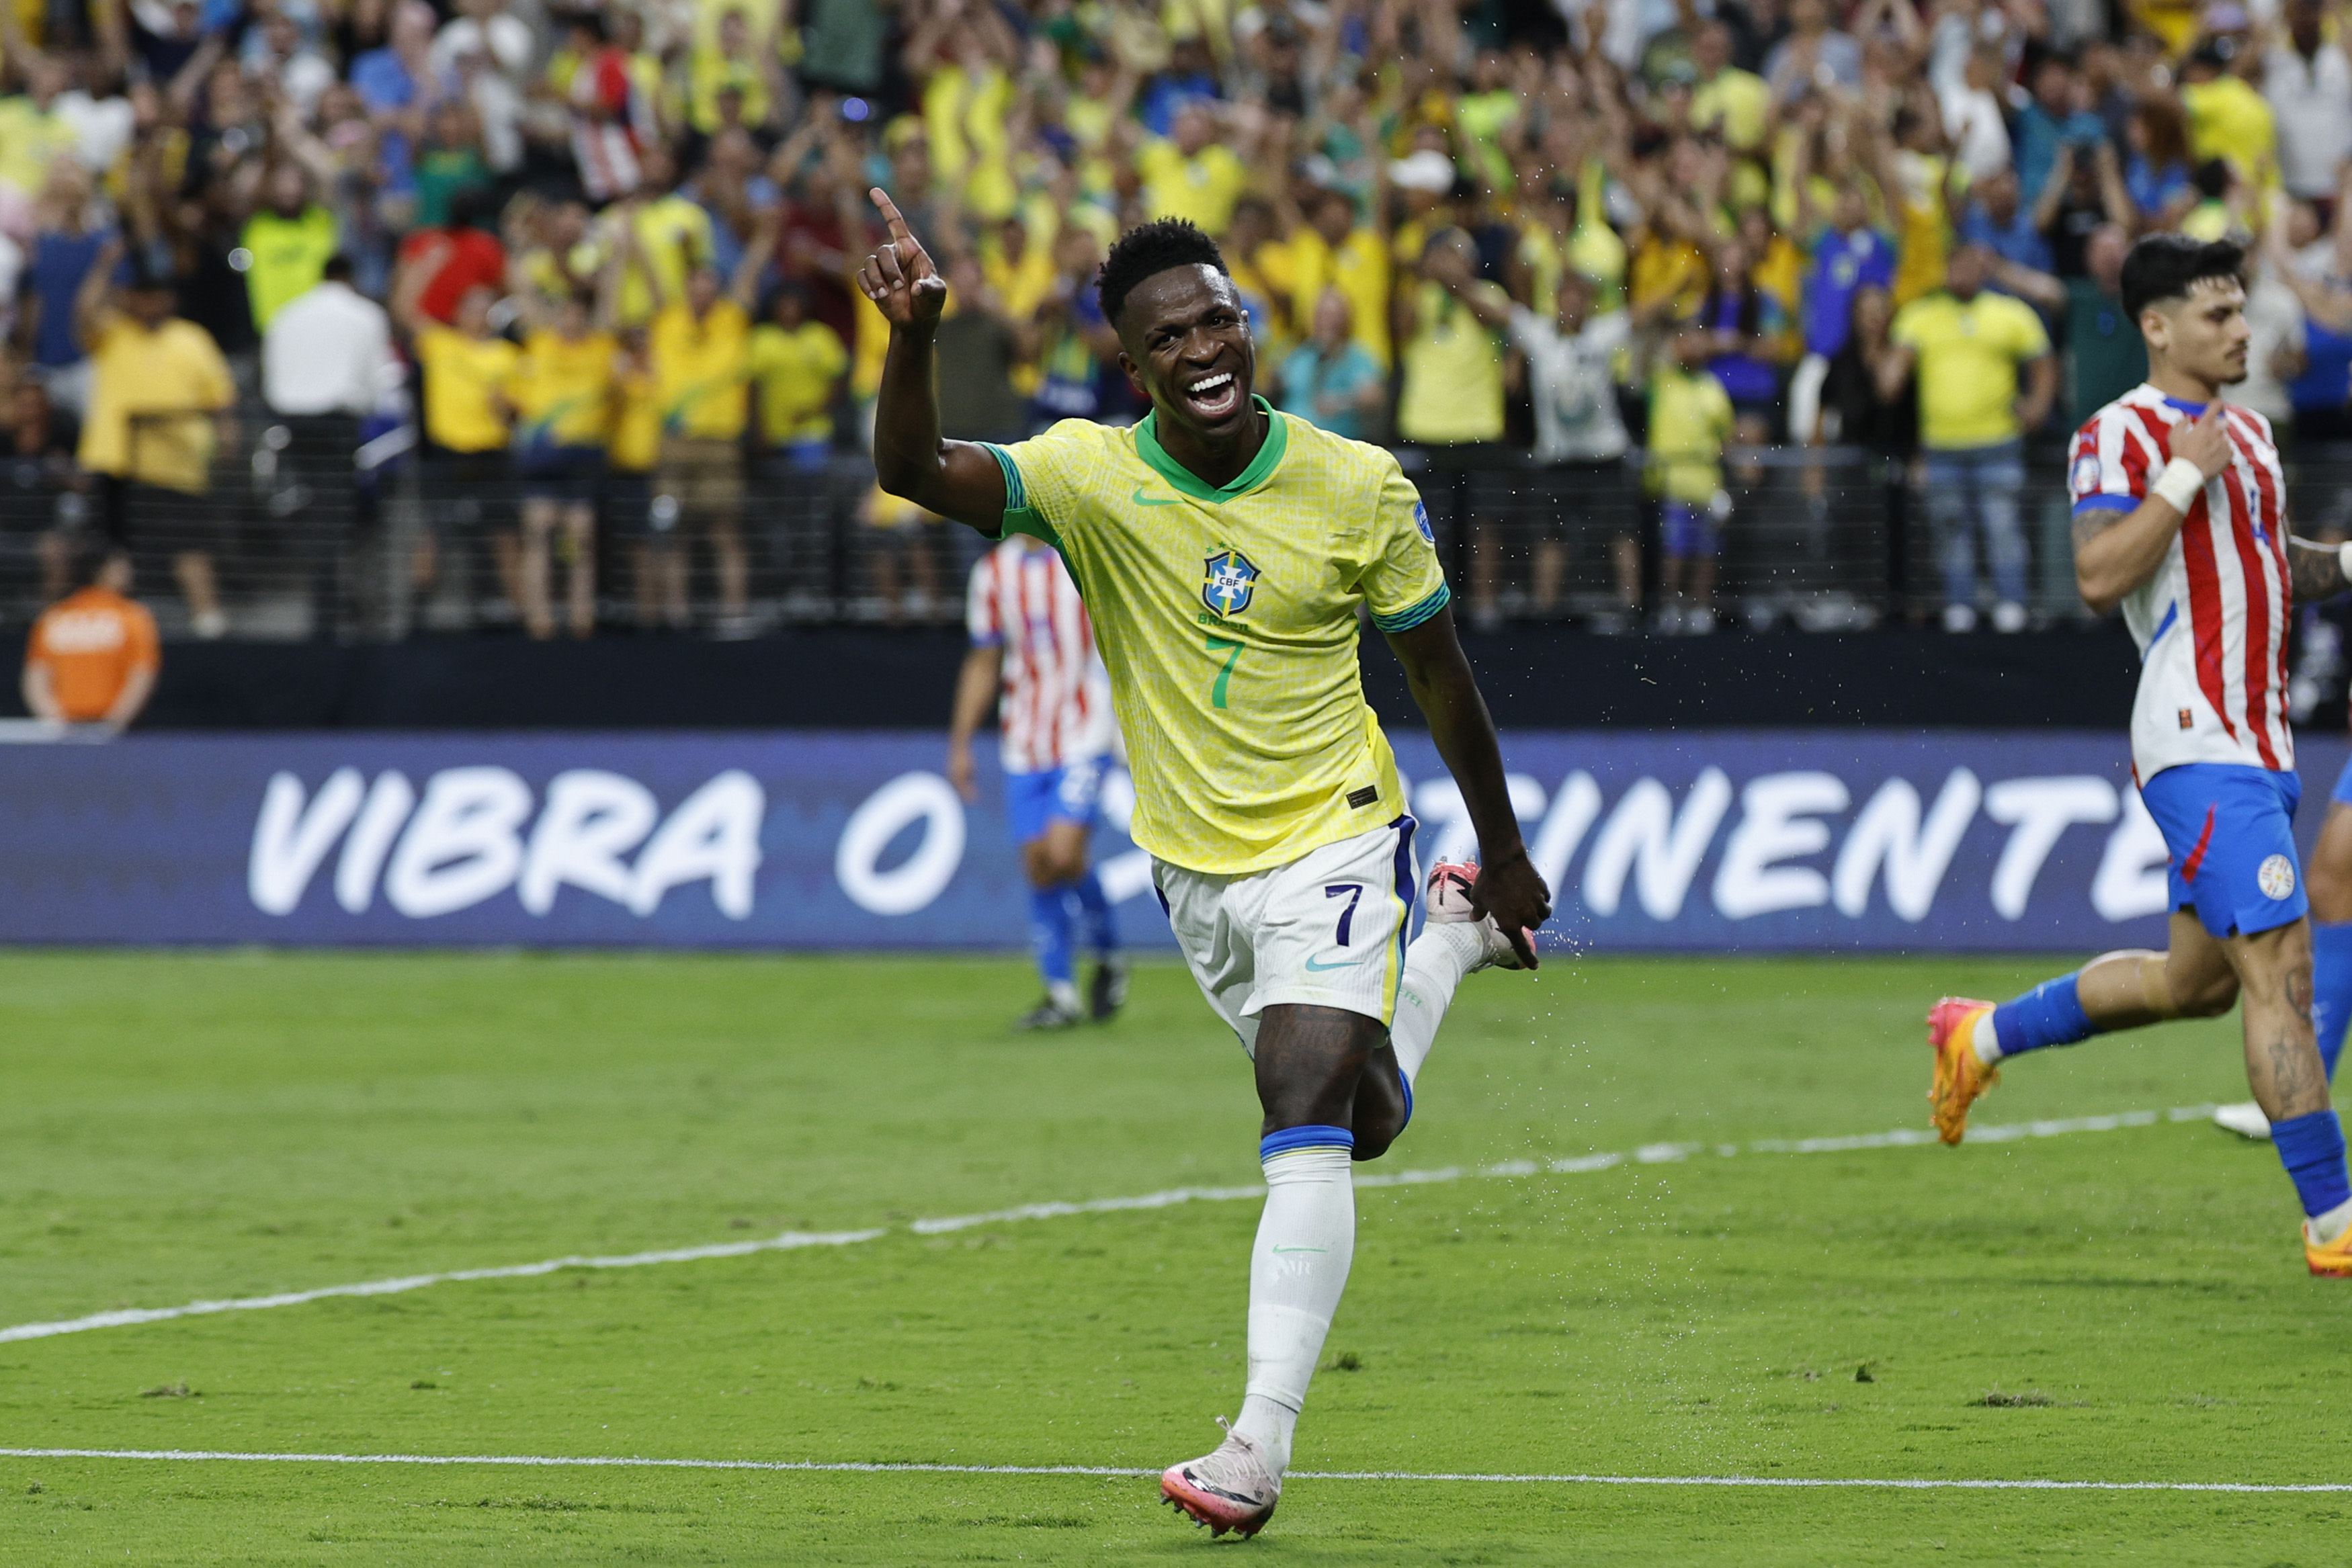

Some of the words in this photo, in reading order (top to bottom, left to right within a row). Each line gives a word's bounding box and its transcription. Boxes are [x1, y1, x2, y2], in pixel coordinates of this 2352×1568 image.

[1220, 577, 1240, 587] CBF
[1205, 636, 1246, 709] 7
[247, 765, 767, 920] VIBRA
[834, 771, 967, 916] O
[1325, 884, 1363, 947] 7
